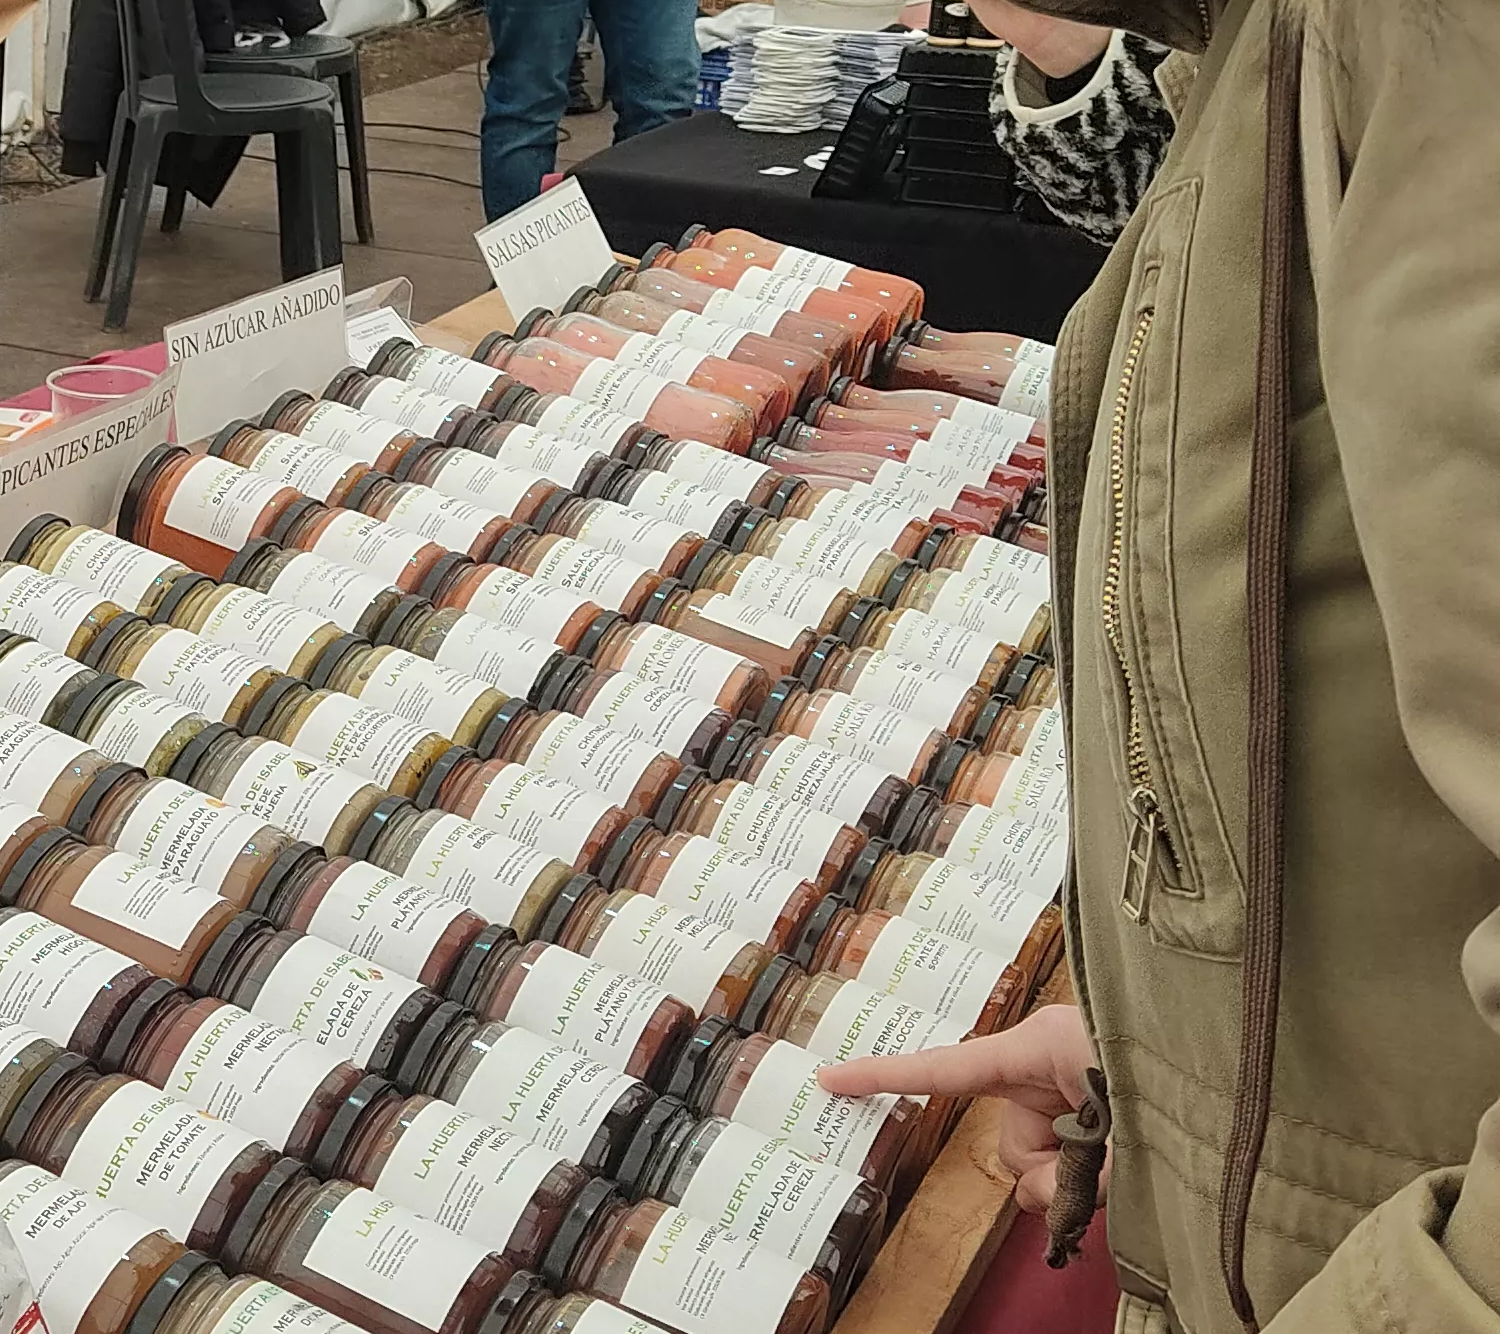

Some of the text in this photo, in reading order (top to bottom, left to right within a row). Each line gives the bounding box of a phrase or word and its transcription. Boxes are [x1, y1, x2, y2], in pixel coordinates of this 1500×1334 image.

[486, 195, 591, 270] SALSAS PICANTES
[169, 282, 342, 365] SIN AZÚCAR AÑADIDO
[92, 383, 177, 458] ESPECIALES
[257, 750, 291, 788] ISABEL
[158, 806, 209, 877] MERMELADA
[171, 809, 220, 887] PARAGUAYO
[3, 921, 48, 959] HUERTA
[335, 988, 373, 1040] CEREZA
[551, 969, 596, 1037] LA HUERTA
[177, 1026, 225, 1094] LA HUERTA
[501, 1054, 551, 1124] LA HUERTA
[535, 1055, 590, 1124] MERMELADA
[133, 1118, 154, 1140] DE
[136, 1112, 198, 1187] MERMELADA
[158, 1123, 208, 1182] DE TOMATE
[414, 1114, 468, 1181] LA HUERTA
[53, 1200, 88, 1230] DE AJO
[781, 1167, 817, 1213] CEREZA
